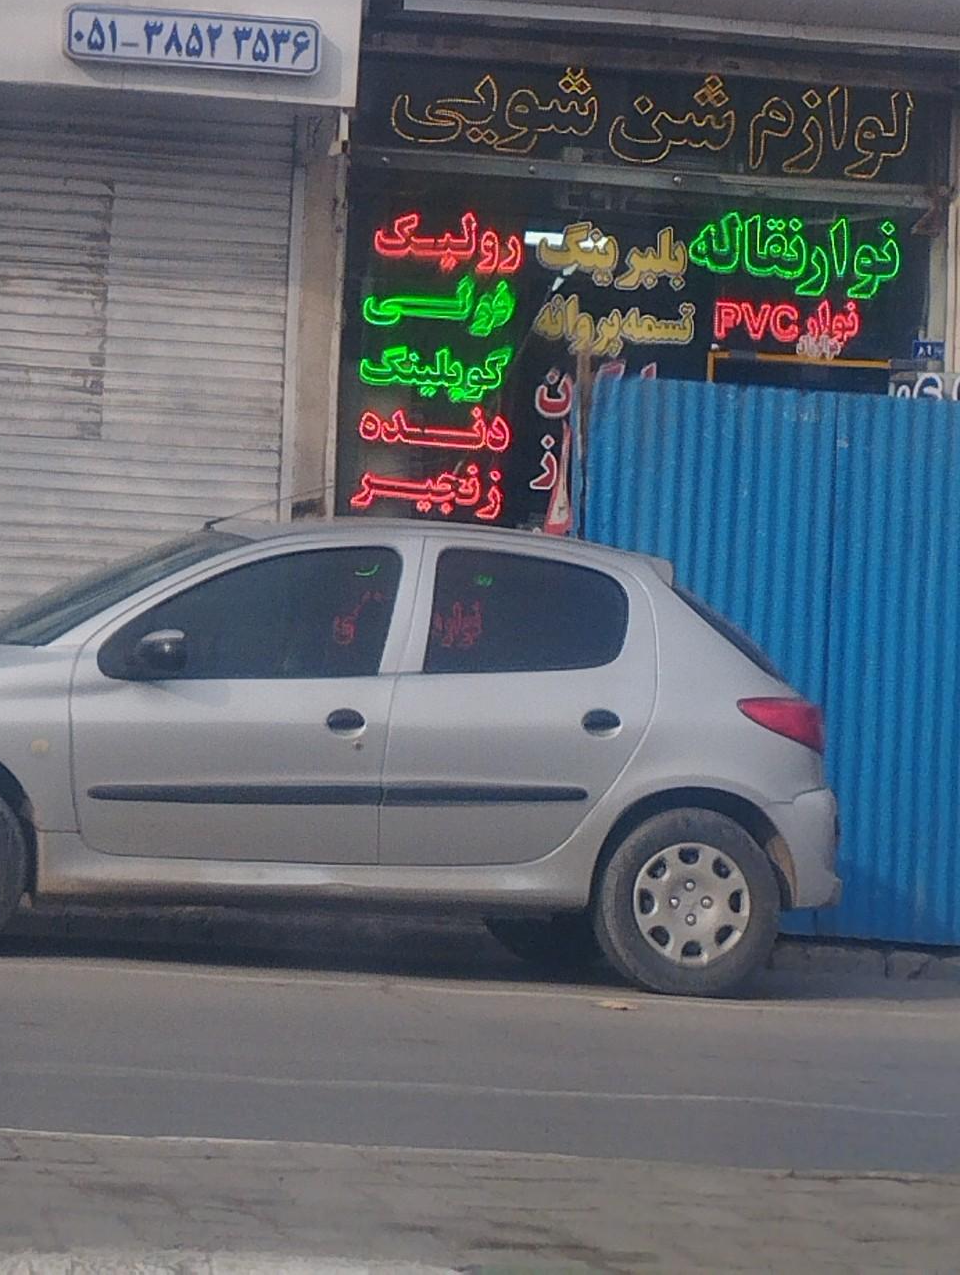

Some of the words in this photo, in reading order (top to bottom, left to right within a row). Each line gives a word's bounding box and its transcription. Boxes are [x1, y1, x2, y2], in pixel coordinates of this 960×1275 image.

[390, 66, 599, 153] شویی
[608, 74, 736, 164] شن
[749, 86, 915, 179] لوازم
[374, 211, 523, 272] رولیک
[536, 221, 688, 291] بلبرینگ
[714, 301, 800, 342] PVC
